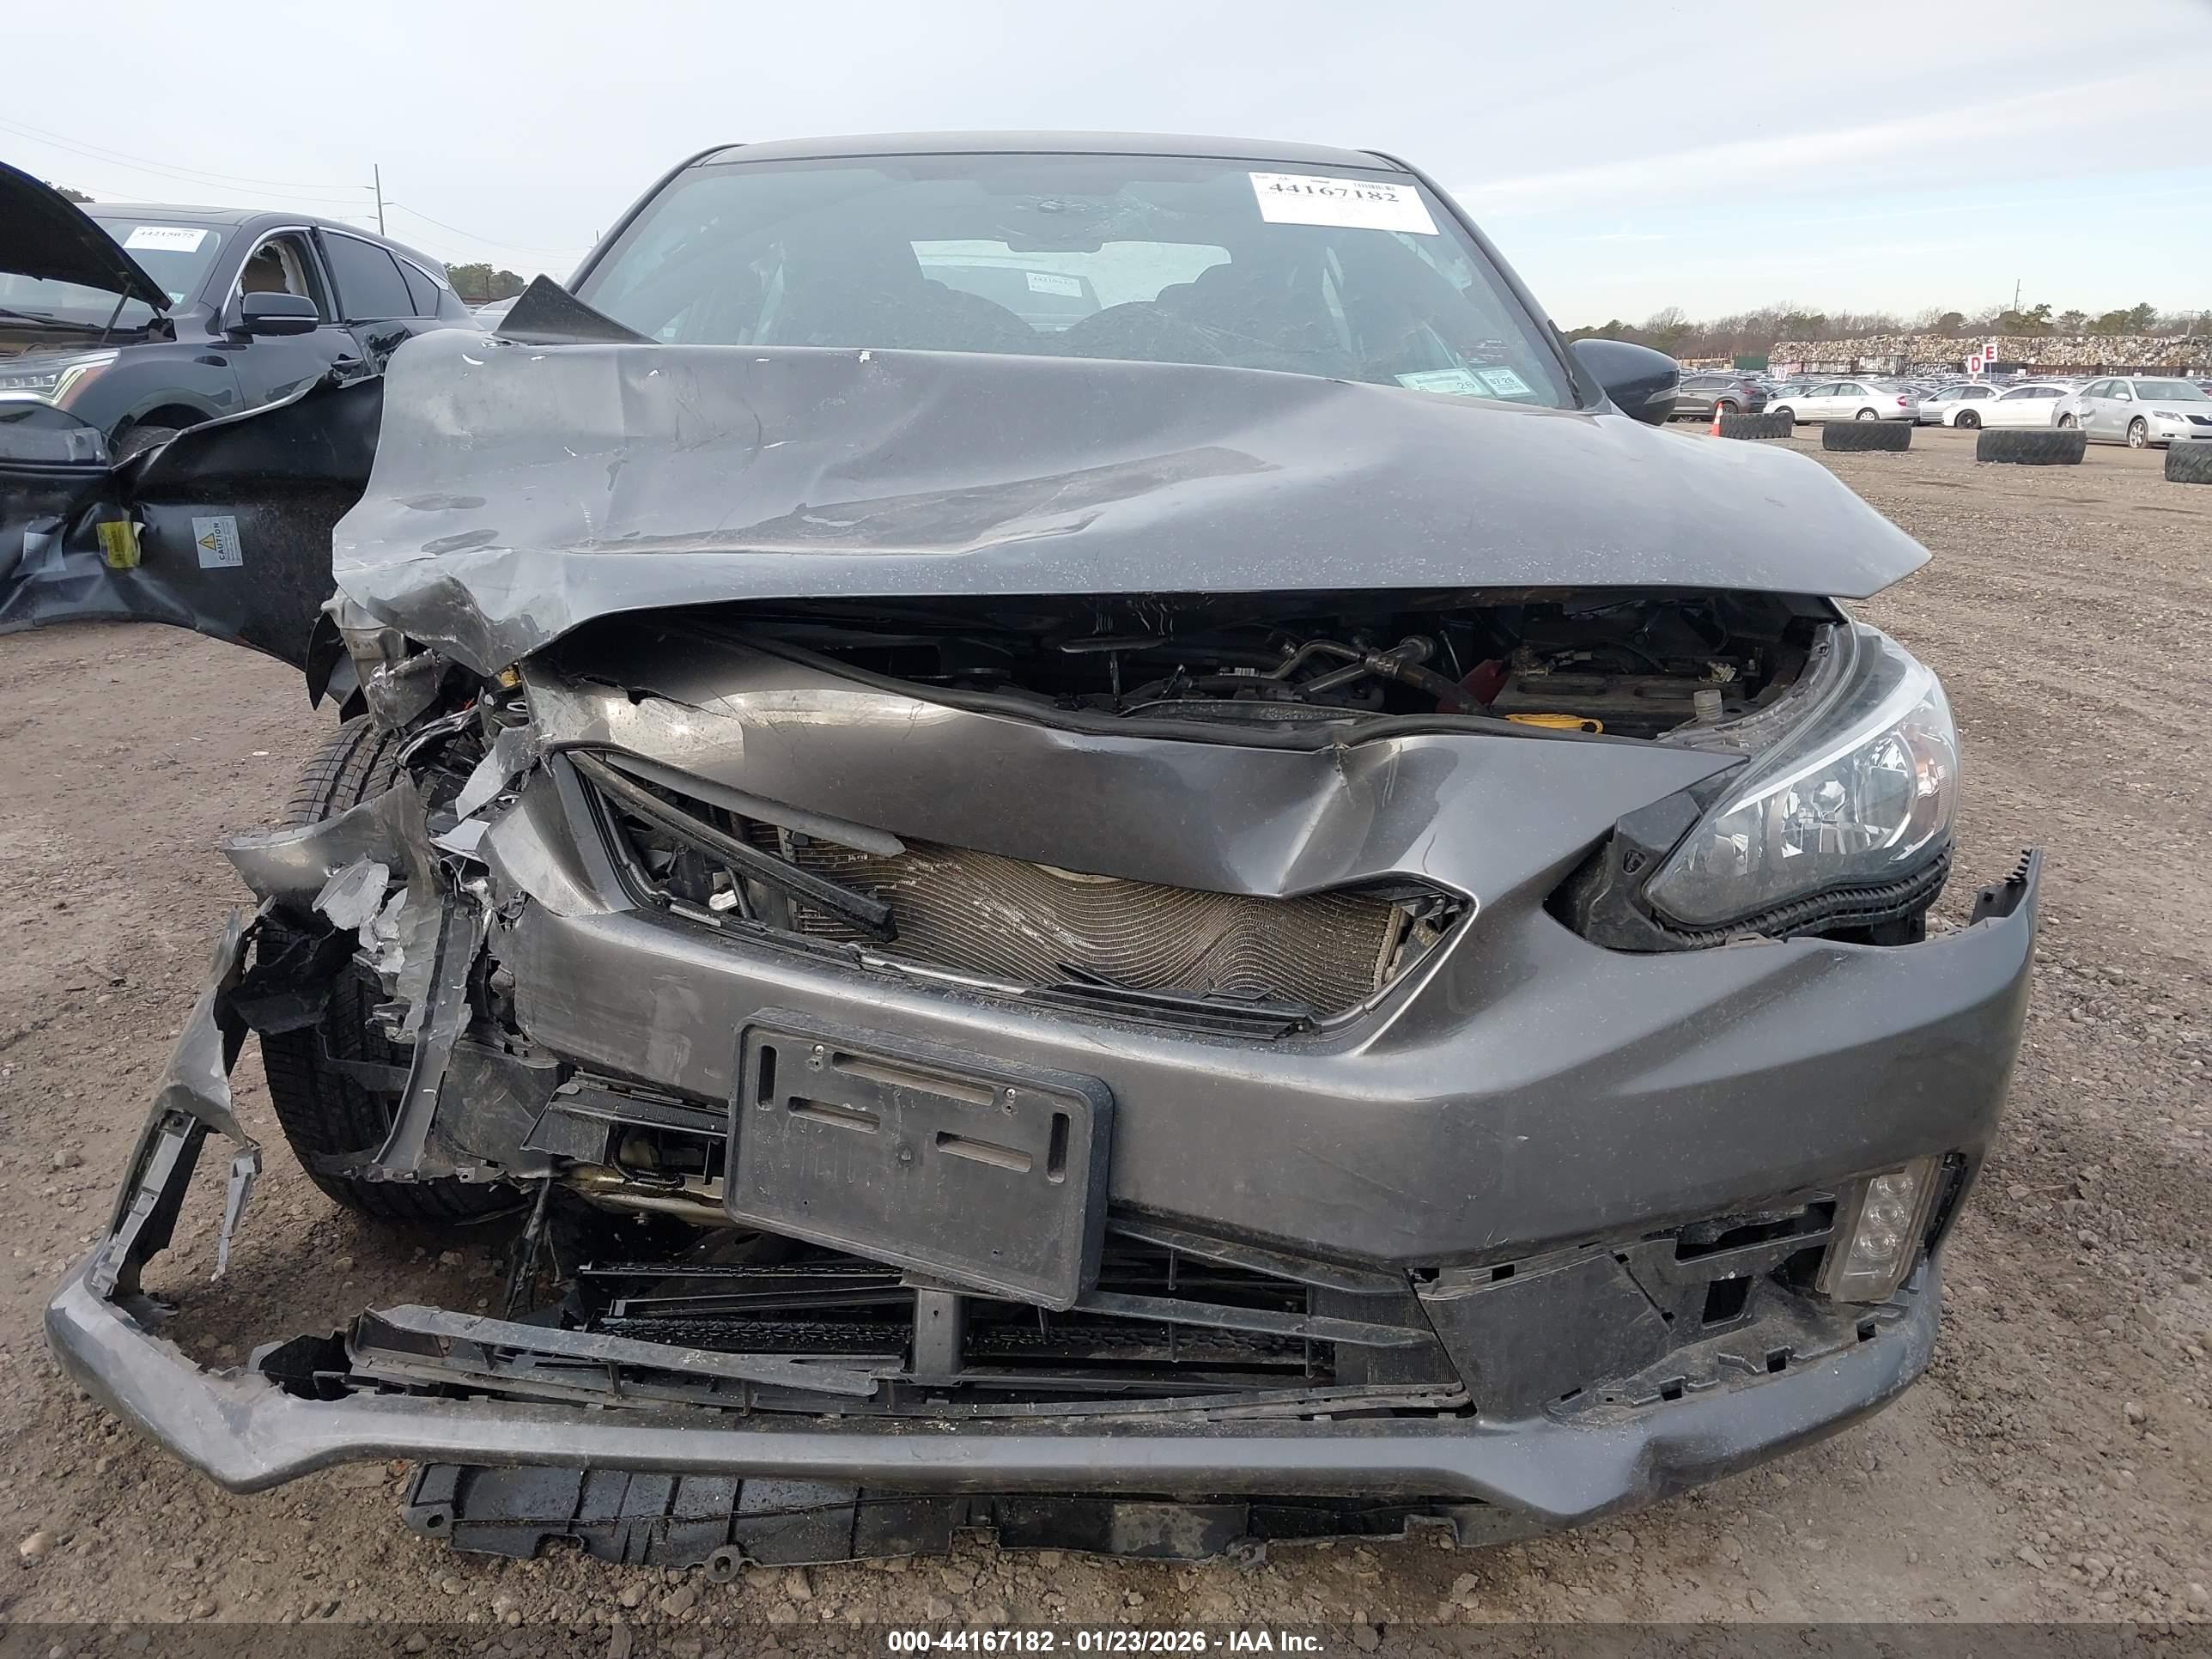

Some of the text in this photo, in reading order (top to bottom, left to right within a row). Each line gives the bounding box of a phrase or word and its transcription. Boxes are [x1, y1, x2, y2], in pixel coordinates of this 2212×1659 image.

[1269, 183, 1400, 203] 44167182
[1986, 346, 1994, 359] E
[1972, 357, 1980, 372] D
[213, 522, 226, 561] CAUTION
